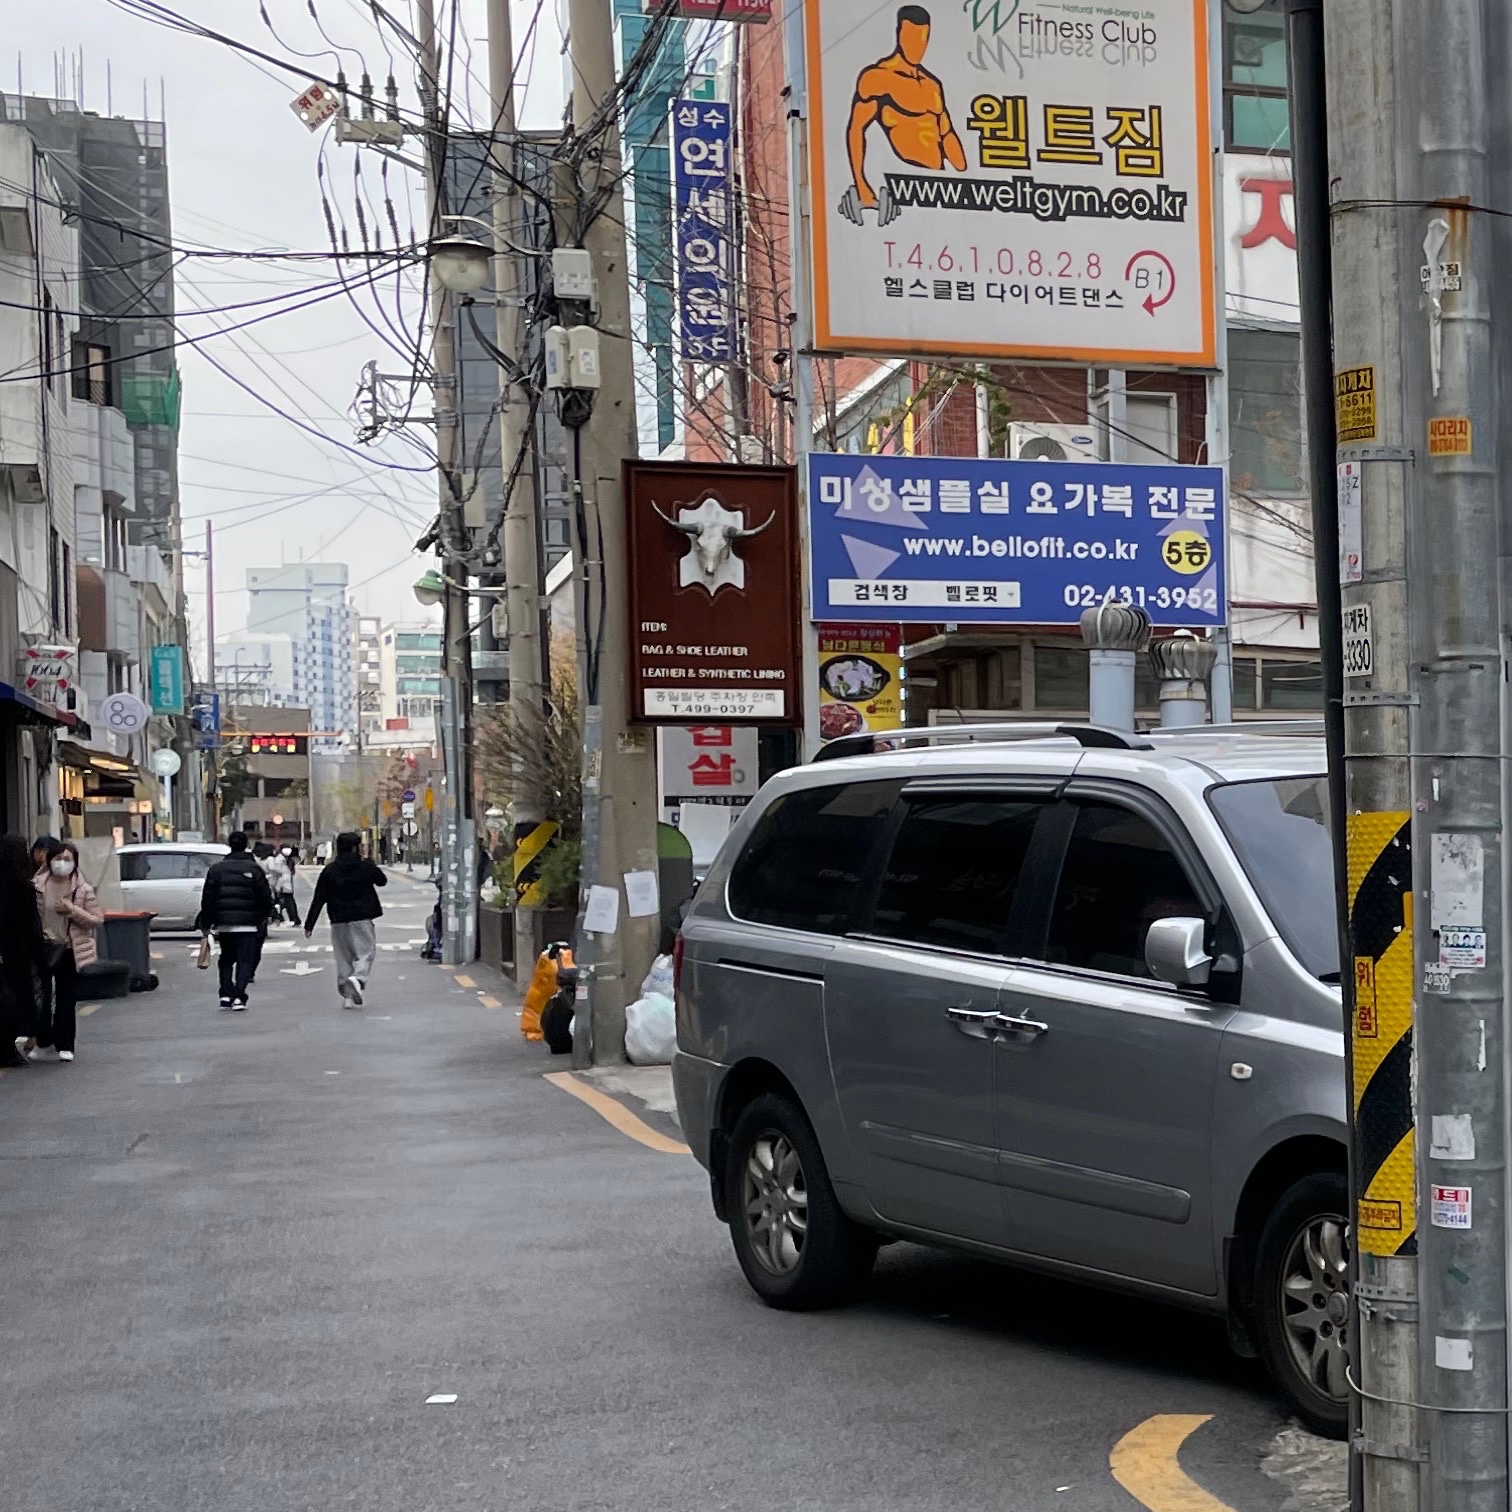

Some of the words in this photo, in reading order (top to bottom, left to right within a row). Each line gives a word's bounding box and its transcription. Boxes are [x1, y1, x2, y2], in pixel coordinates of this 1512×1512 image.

[1018, 13, 1094, 40] Fitness
[1101, 20, 1157, 45] Club
[678, 107, 726, 130] 성수
[967, 95, 1164, 178] 웰트짐
[889, 178, 1184, 218] www.weltgym.co.kr
[679, 137, 729, 325] 연세의원
[884, 277, 975, 301] 헬스클럽
[987, 283, 1124, 308] 다이어트댄스
[819, 475, 1010, 515] 미성샘플실
[1026, 481, 1134, 519] 요가복
[1148, 485, 1216, 521] 전문
[903, 535, 1139, 561] www.bellofit.co.kr
[1165, 541, 1208, 566] 5층
[946, 584, 999, 603] 벨로핏
[1063, 584, 1218, 610] 02-431-3952
[705, 647, 748, 656] LEATHER
[642, 667, 686, 678] LEATHER
[698, 669, 750, 679] SYNTHETIC
[671, 704, 755, 714] T.499-0397
